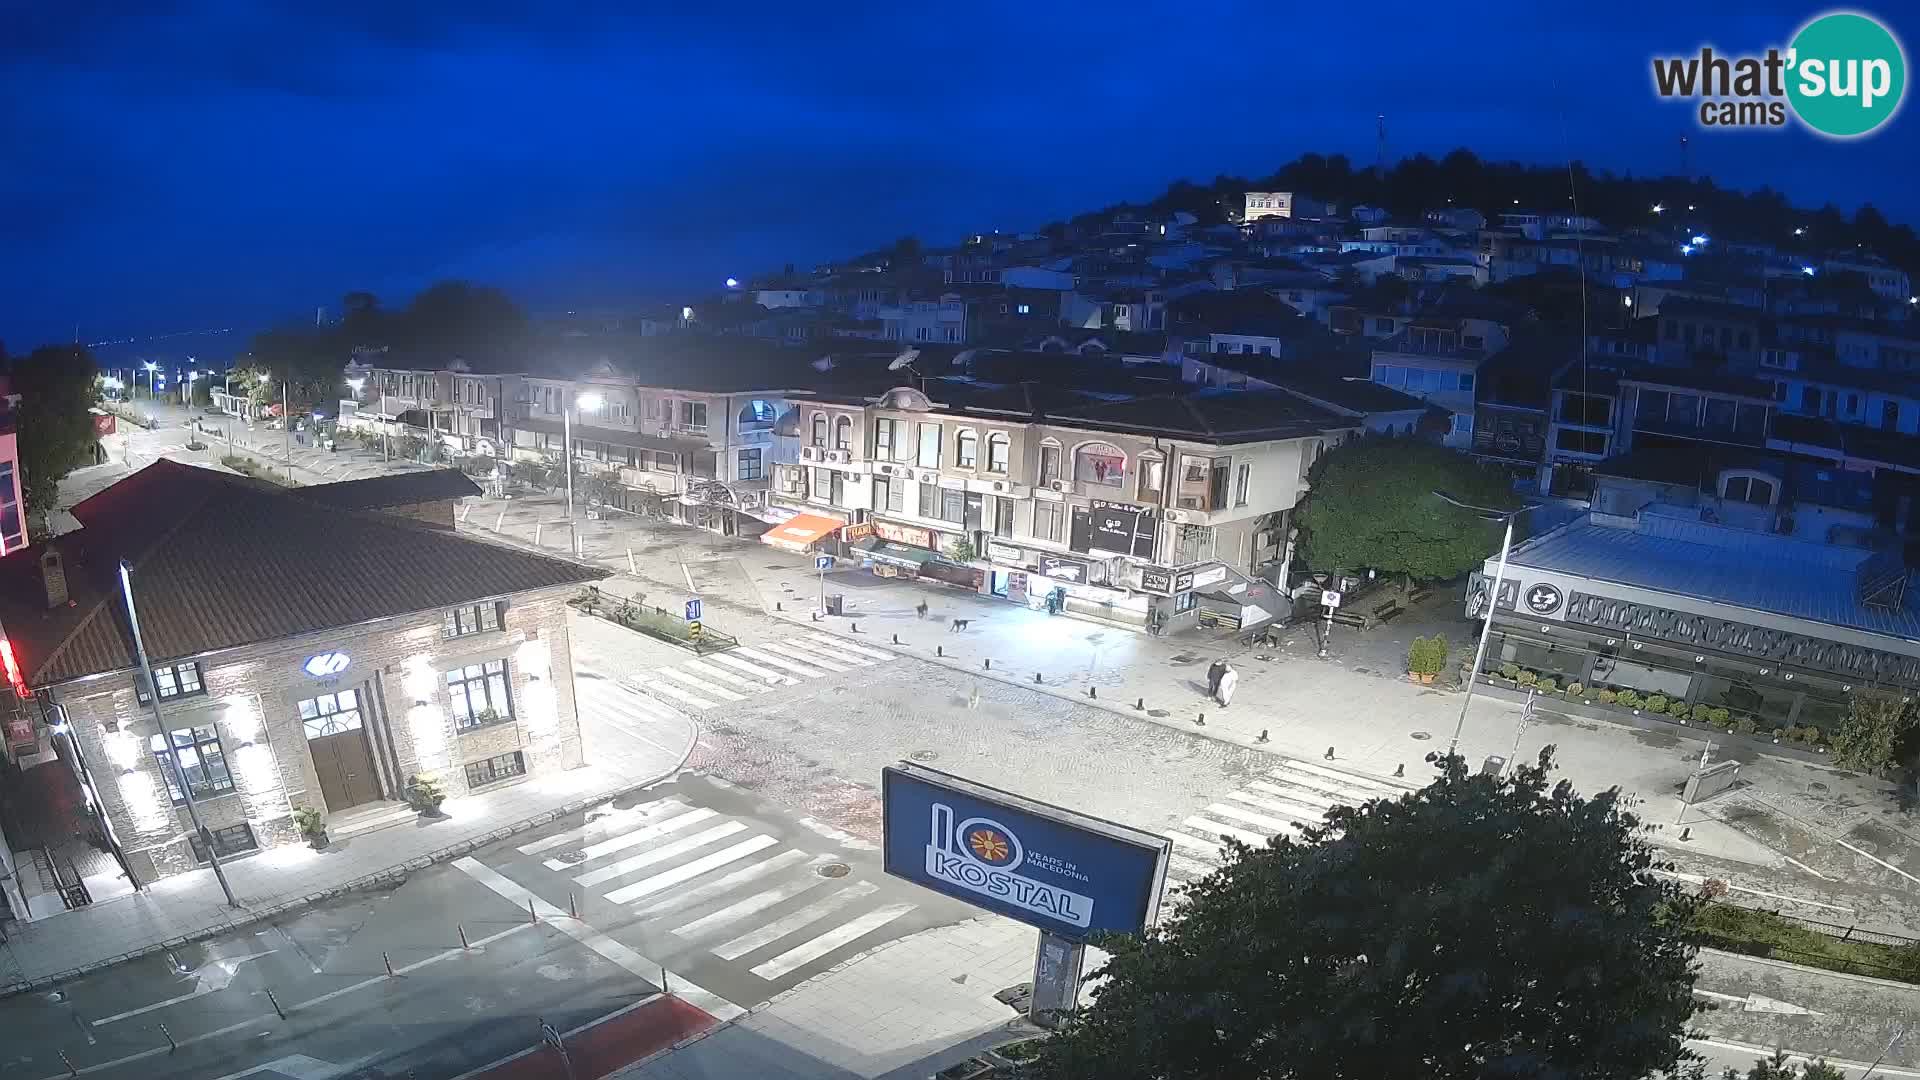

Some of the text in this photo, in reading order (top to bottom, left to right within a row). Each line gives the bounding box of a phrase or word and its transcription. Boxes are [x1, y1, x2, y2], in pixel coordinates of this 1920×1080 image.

[819, 558, 827, 568] P
[1027, 851, 1077, 871] YEARS IN
[1027, 858, 1089, 882] MACEDONIA
[936, 853, 1080, 920] KOSTAL
